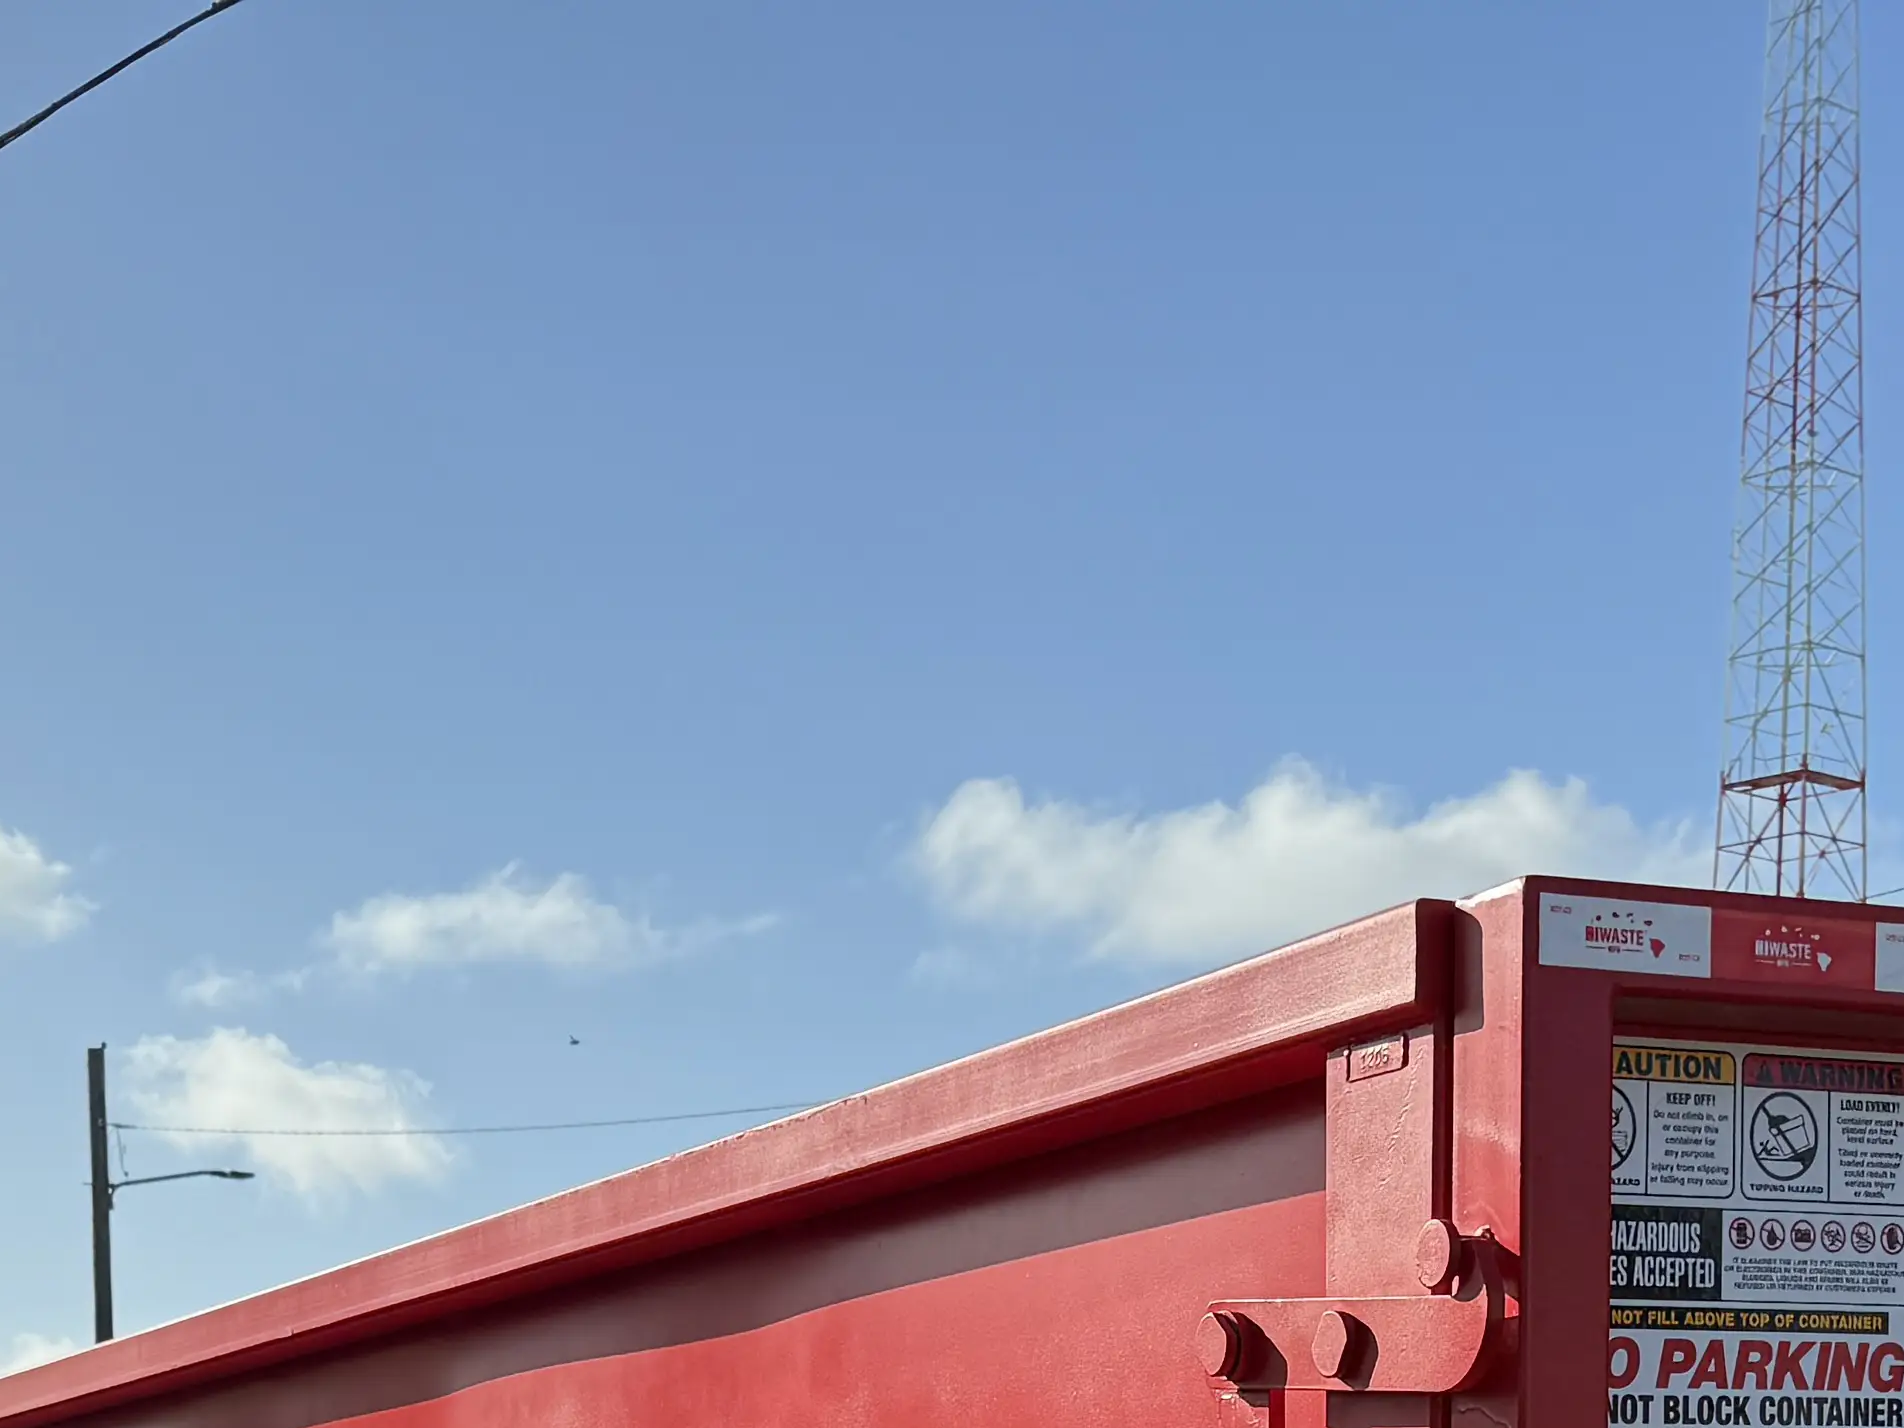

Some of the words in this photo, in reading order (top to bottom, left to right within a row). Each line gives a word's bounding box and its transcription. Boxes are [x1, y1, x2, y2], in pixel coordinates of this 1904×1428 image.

[1615, 1051, 1721, 1080] AUTION
[1780, 1060, 1904, 1090] WARNING
[1666, 1092, 1691, 1106] KEEP
[1694, 1094, 1716, 1107] OFF!
[1633, 1255, 1715, 1288] ACCEPTED
[1612, 1308, 1643, 1325] NOT
[1647, 1309, 1679, 1325] FILL
[1684, 1310, 1735, 1327] ABOVE
[1740, 1312, 1770, 1328] TOP
[1774, 1313, 1794, 1328] OF
[1799, 1313, 1884, 1331] CONTAINER
[1608, 1336, 1641, 1389] O
[1663, 1394, 1751, 1426] BLOCK
[1760, 1395, 1903, 1428] CONTAINER
